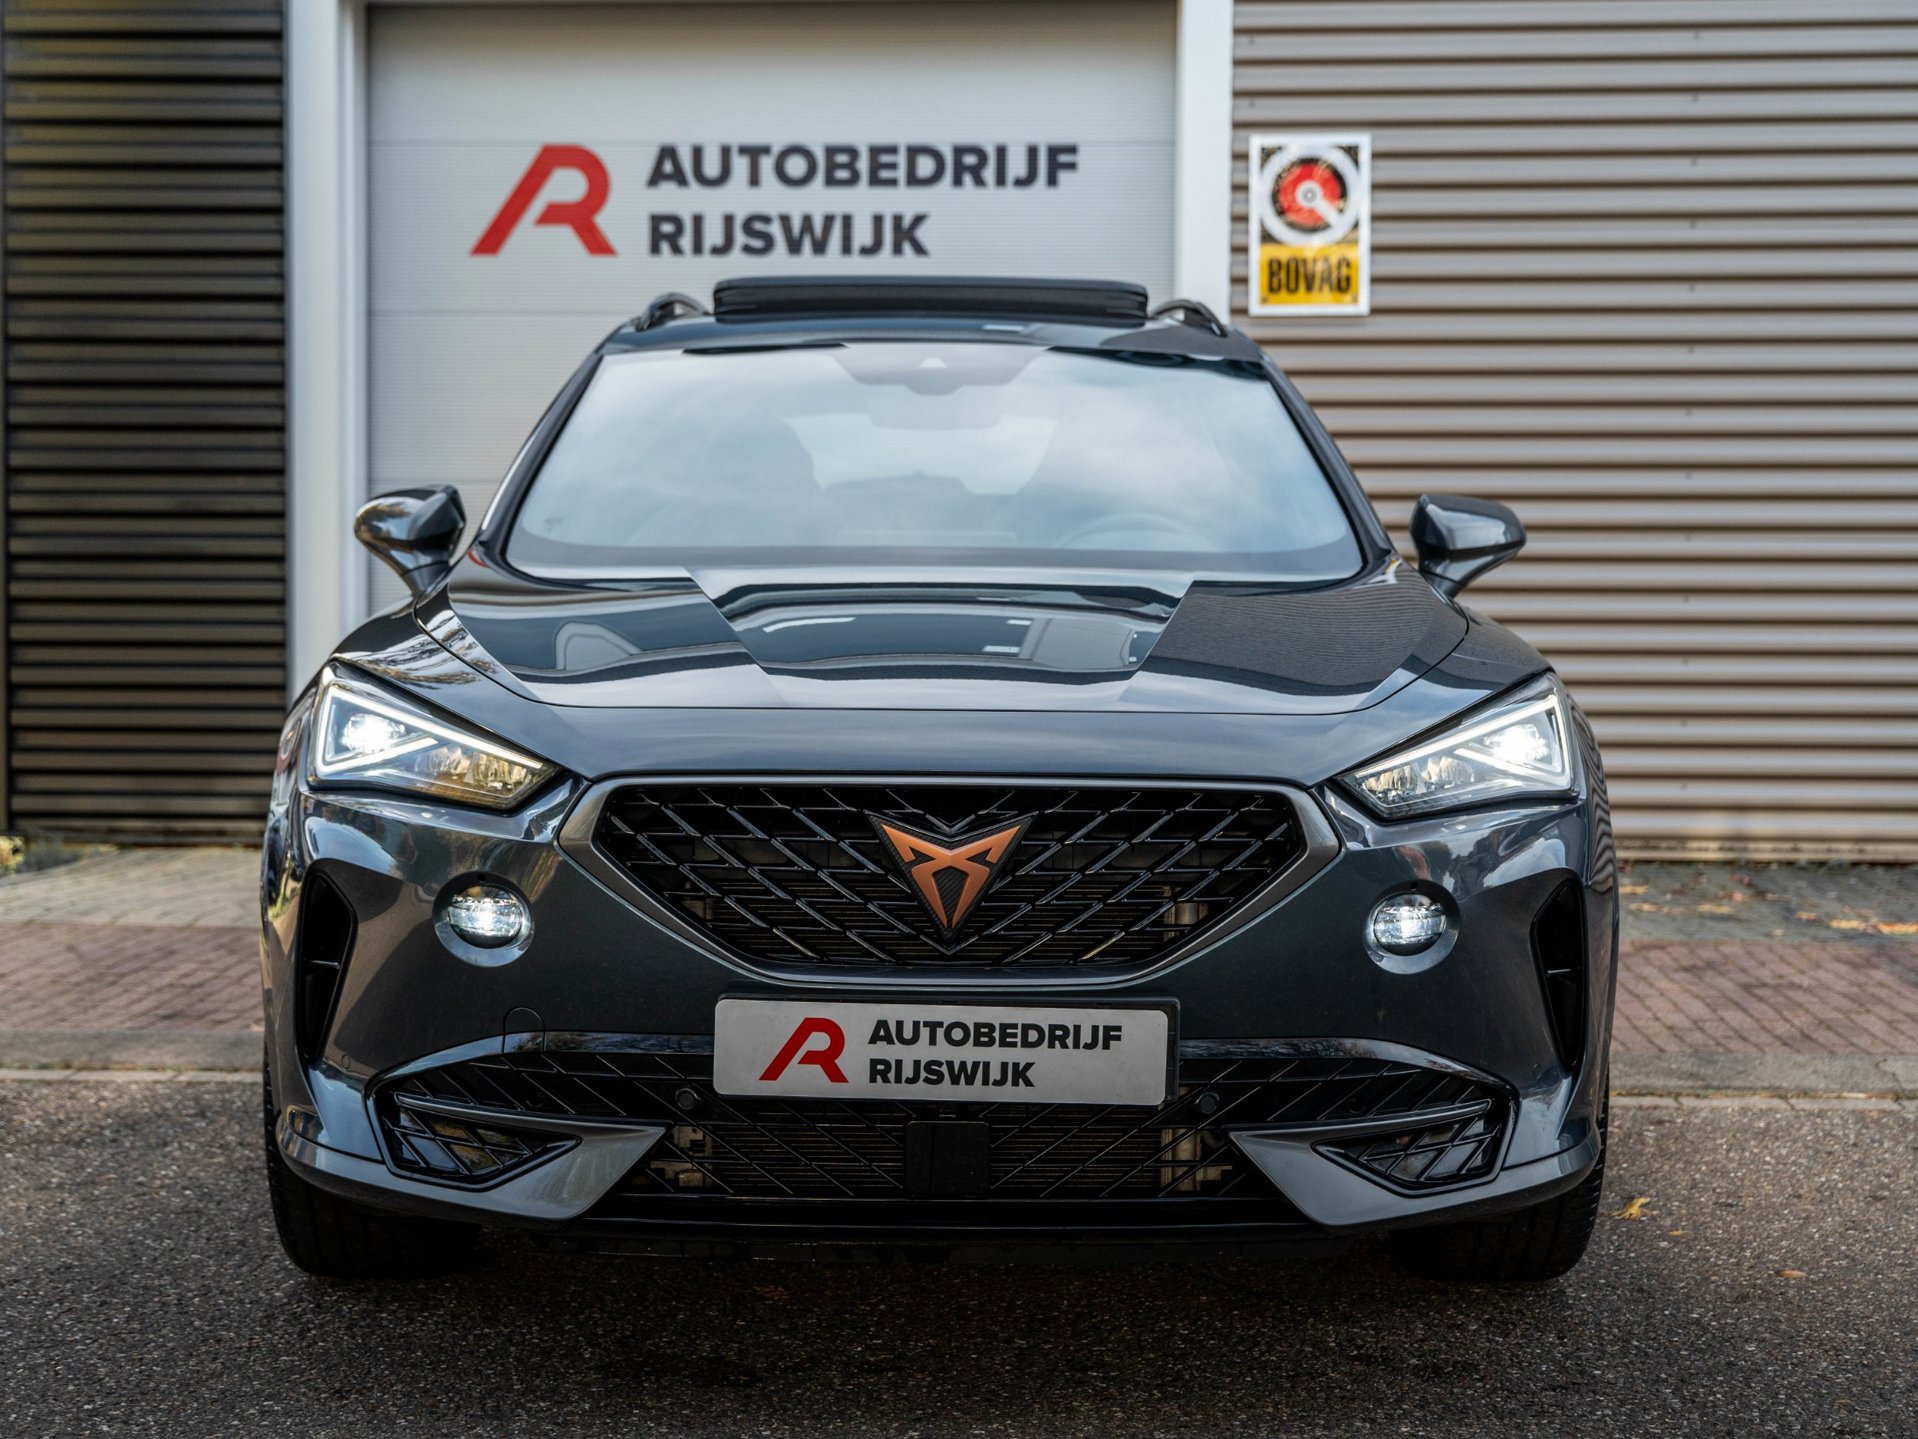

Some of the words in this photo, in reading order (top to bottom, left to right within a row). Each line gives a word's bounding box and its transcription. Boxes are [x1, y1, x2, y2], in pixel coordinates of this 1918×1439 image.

[647, 144, 1079, 188] AUTOBEDRIJF
[650, 213, 929, 257] RIJSWIJK
[1268, 258, 1351, 293] BOVAG
[867, 1019, 1122, 1051] AUTOBEDRIJF
[868, 1058, 1036, 1087] RIJSWIJK
